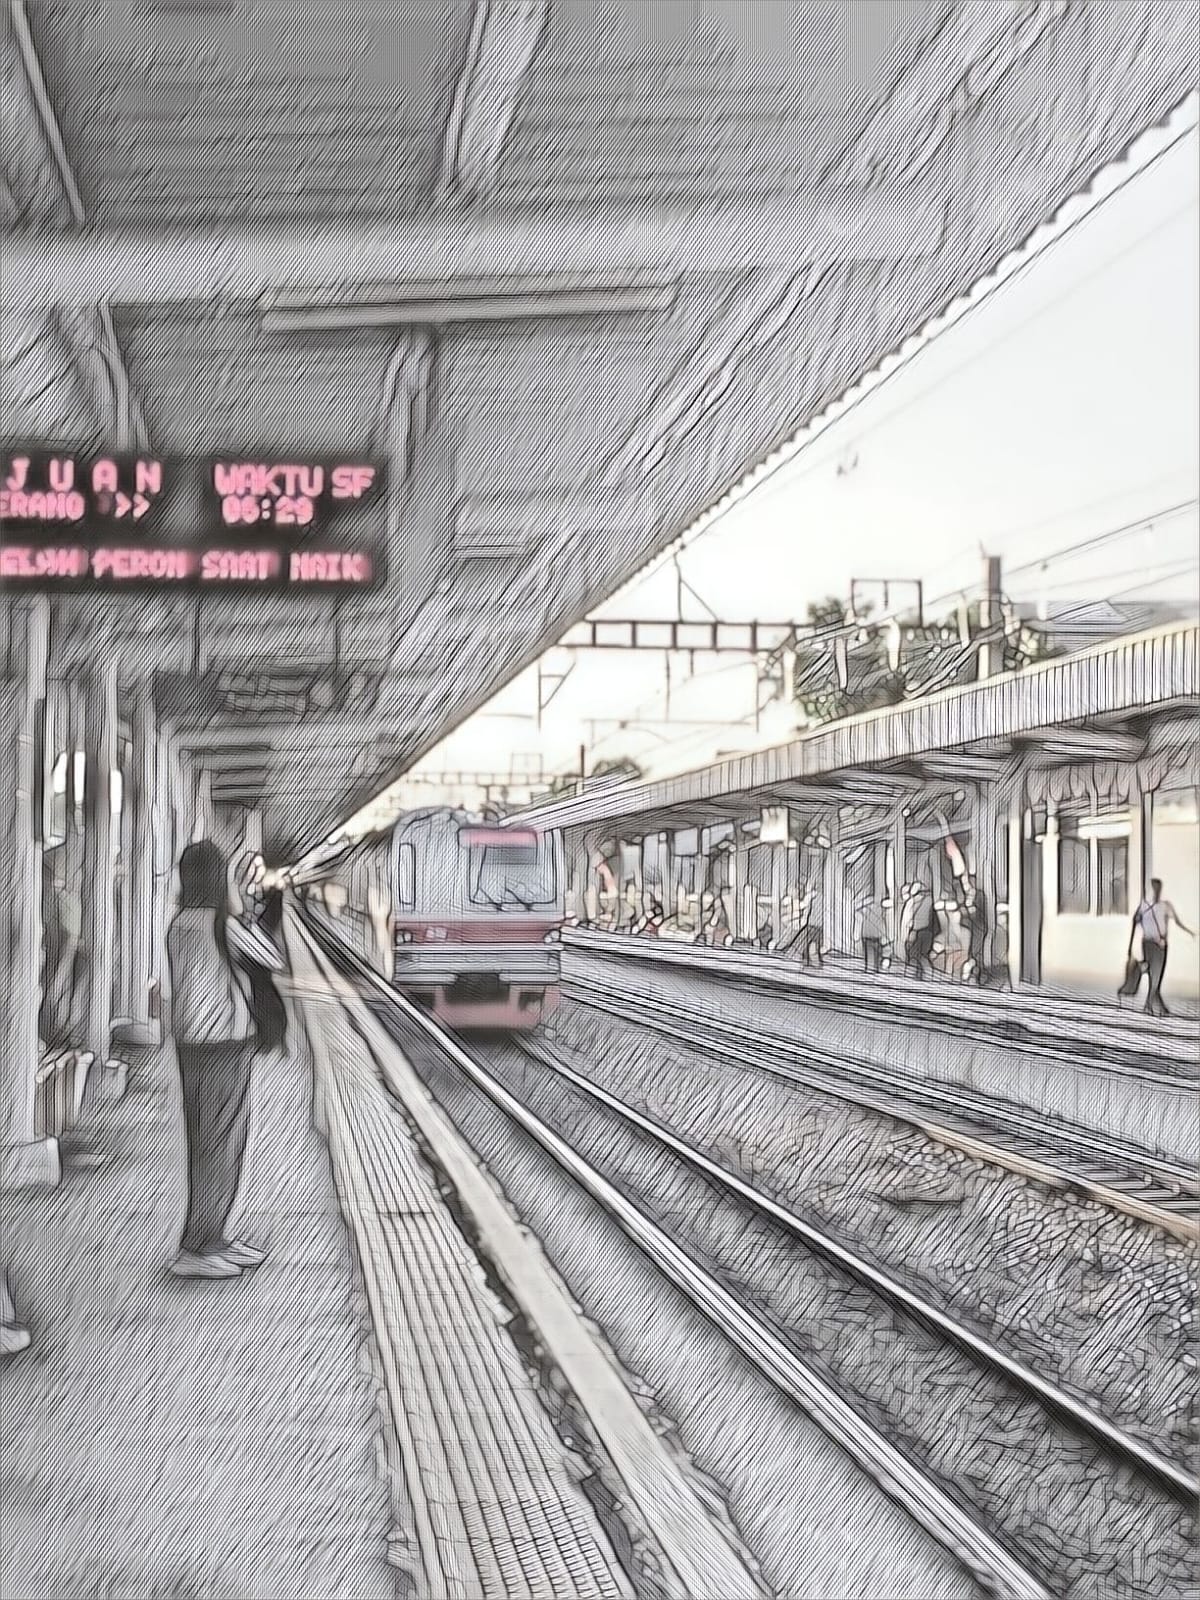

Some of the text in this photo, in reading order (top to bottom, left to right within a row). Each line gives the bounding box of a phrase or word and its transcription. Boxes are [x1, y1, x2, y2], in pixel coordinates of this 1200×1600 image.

[213, 463, 324, 498] WAKTU
[92, 548, 189, 579] PERON
[201, 550, 271, 581] SAAT
[289, 552, 366, 582] NAIK
